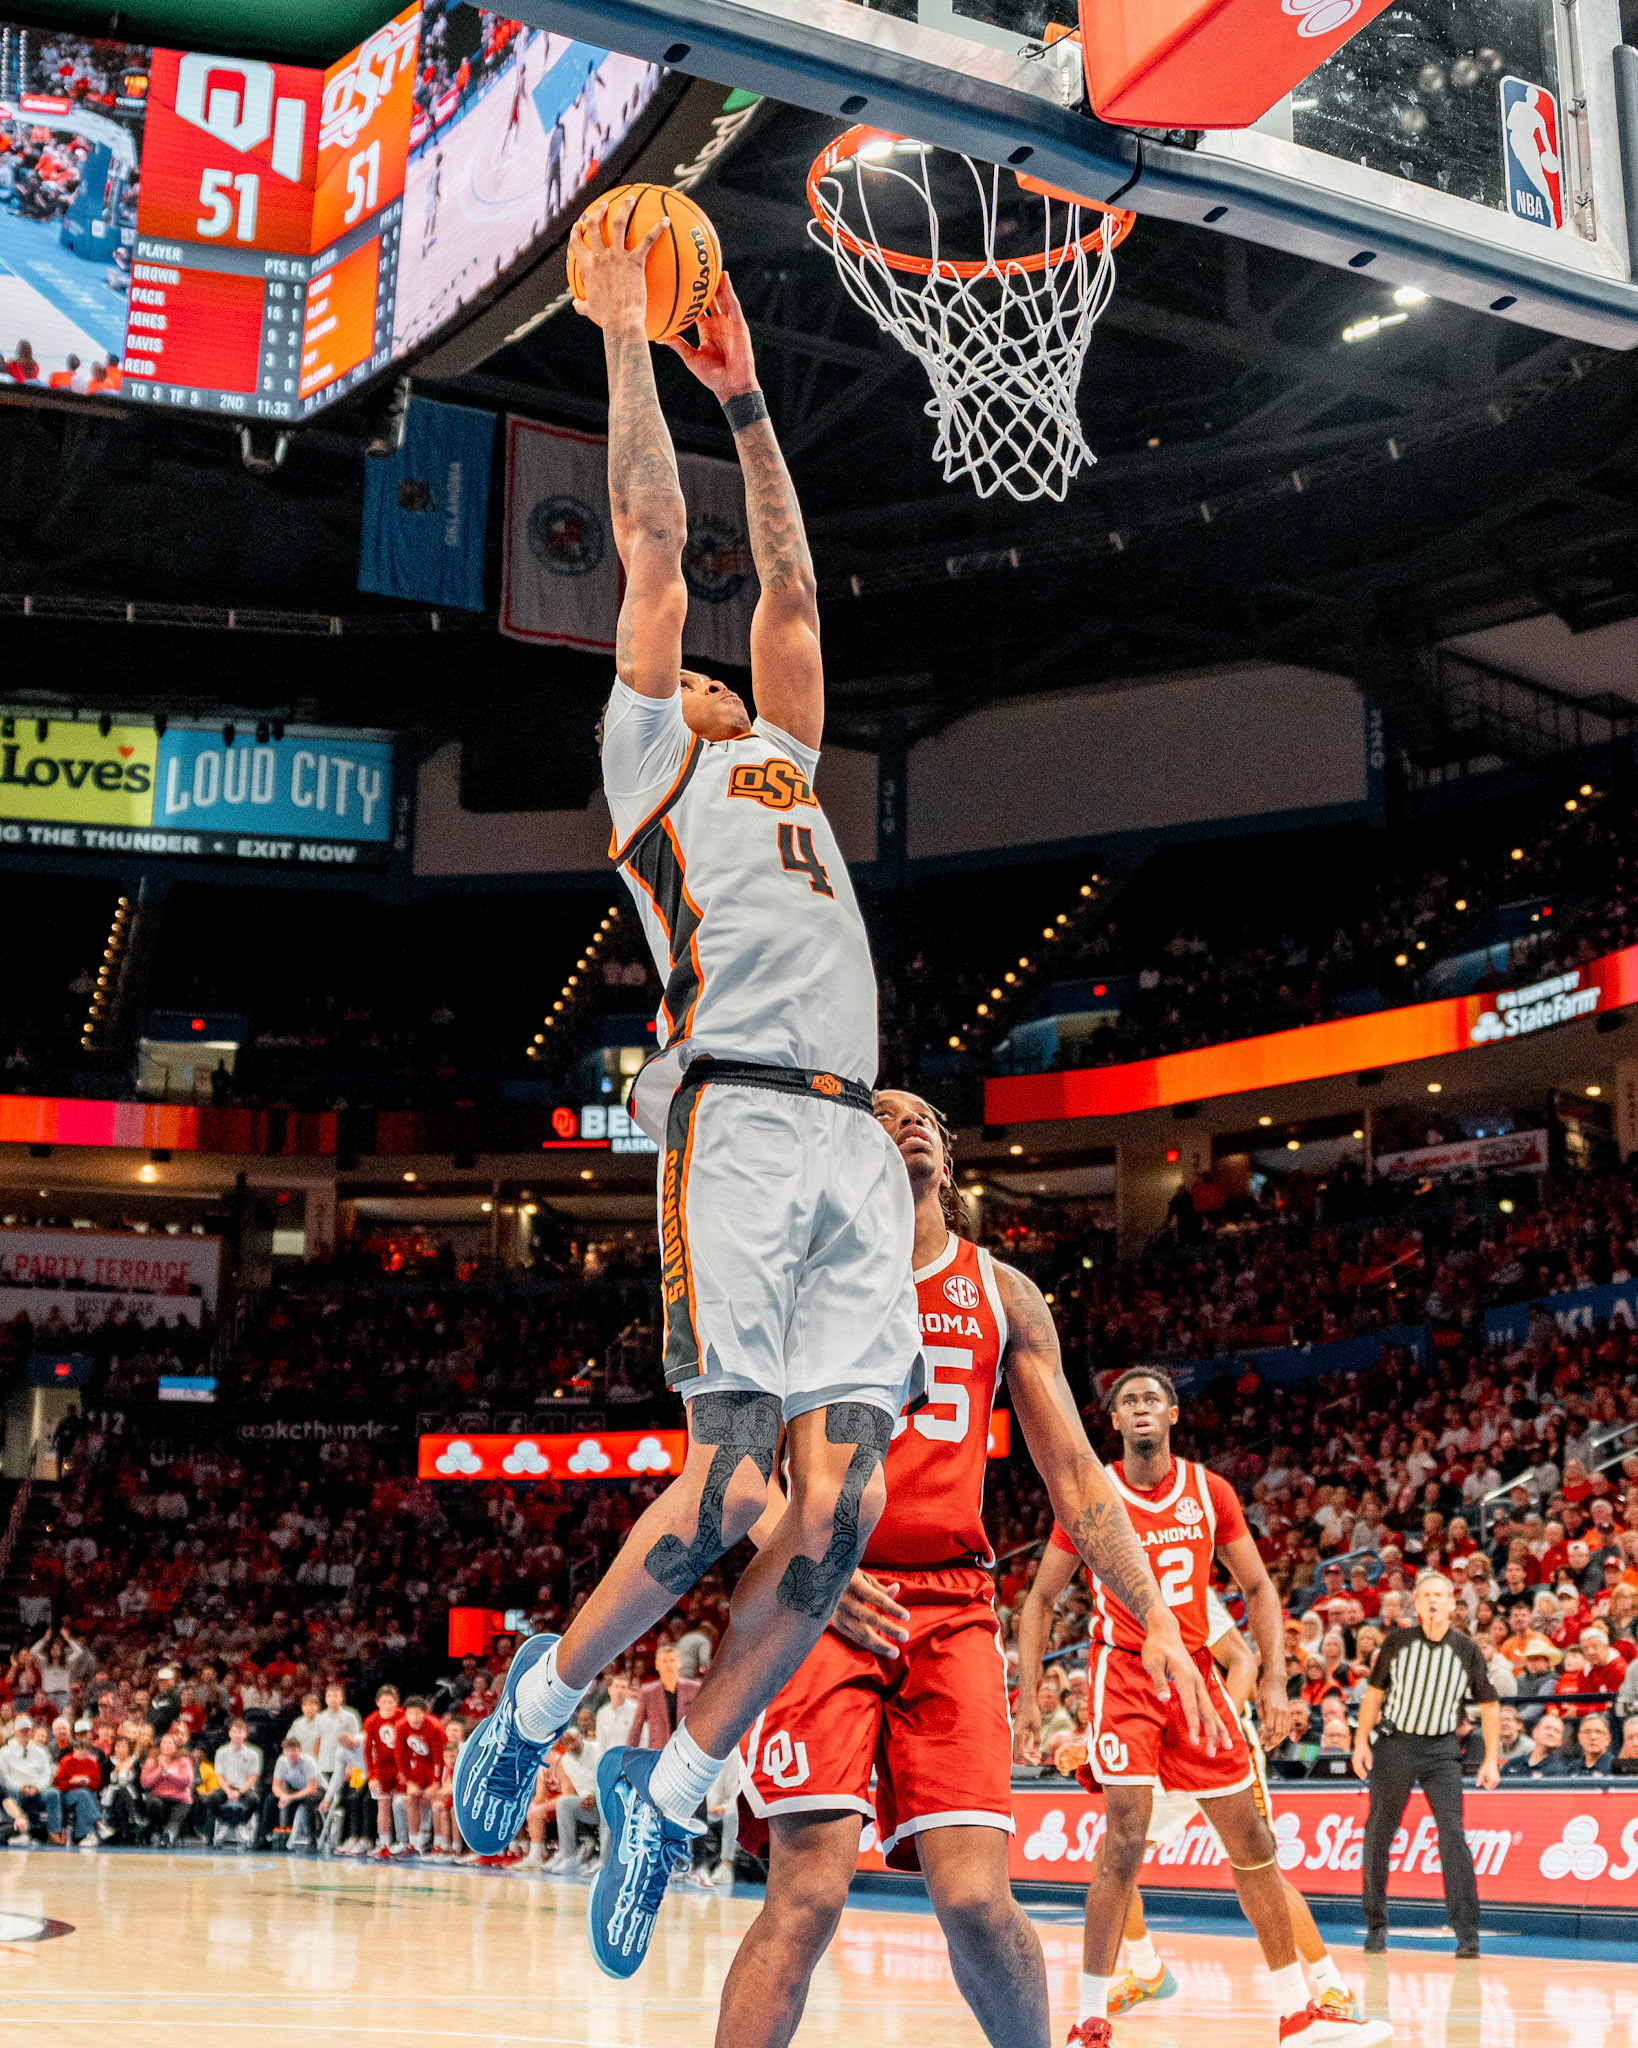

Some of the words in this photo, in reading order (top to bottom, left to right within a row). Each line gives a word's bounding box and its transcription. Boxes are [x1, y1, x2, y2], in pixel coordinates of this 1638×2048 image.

[344, 140, 380, 224] 51
[196, 168, 258, 242] 51
[1515, 189, 1544, 220] NBA
[137, 241, 184, 262] PLAYER
[264, 258, 289, 276] PTS
[290, 260, 306, 278] FL
[678, 224, 710, 328] Wilson
[133, 264, 180, 286] BROWN
[268, 282, 286, 299] 10
[293, 284, 302, 300] 1
[131, 287, 165, 307] PACK
[266, 305, 283, 322] 15
[291, 307, 300, 322] 1
[128, 311, 167, 331] JONES
[288, 330, 298, 346] 2
[126, 334, 163, 353] DAVIS
[265, 352, 275, 368] 3
[288, 354, 296, 369] 1
[124, 358, 156, 376] REID
[263, 375, 274, 391] 5
[283, 377, 294, 393] 0
[131, 382, 147, 399] TO
[152, 385, 163, 401] 3
[169, 388, 186, 403] TF
[190, 390, 201, 405] 5
[219, 393, 245, 410] 2ND
[256, 399, 291, 416] 11:33
[164, 746, 276, 816] LOUD
[290, 750, 383, 826] CITY
[727, 757, 819, 812] OSU
[27, 826, 77, 847] THE
[82, 829, 200, 854] THUNDER
[237, 839, 294, 859] EXIT
[299, 844, 357, 863] NOW
[777, 822, 835, 900] 4
[1504, 987, 1600, 1037] StateFarm
[811, 1074, 842, 1095] OSU
[552, 1106, 577, 1139] OU
[662, 1148, 686, 1305] COWBOYS
[14, 1254, 85, 1279] PARTY
[94, 1257, 193, 1285] TERRACE
[945, 1276, 977, 1308] SEC
[895, 1345, 972, 1442] 5
[1136, 1526, 1203, 1547] LAHOMA
[1145, 1547, 1194, 1607] 2
[762, 1729, 810, 1789] OU
[1099, 1732, 1128, 1772] OU
[1066, 1811, 1222, 1866] Starm
[1304, 1814, 1512, 1876] StaeFam
